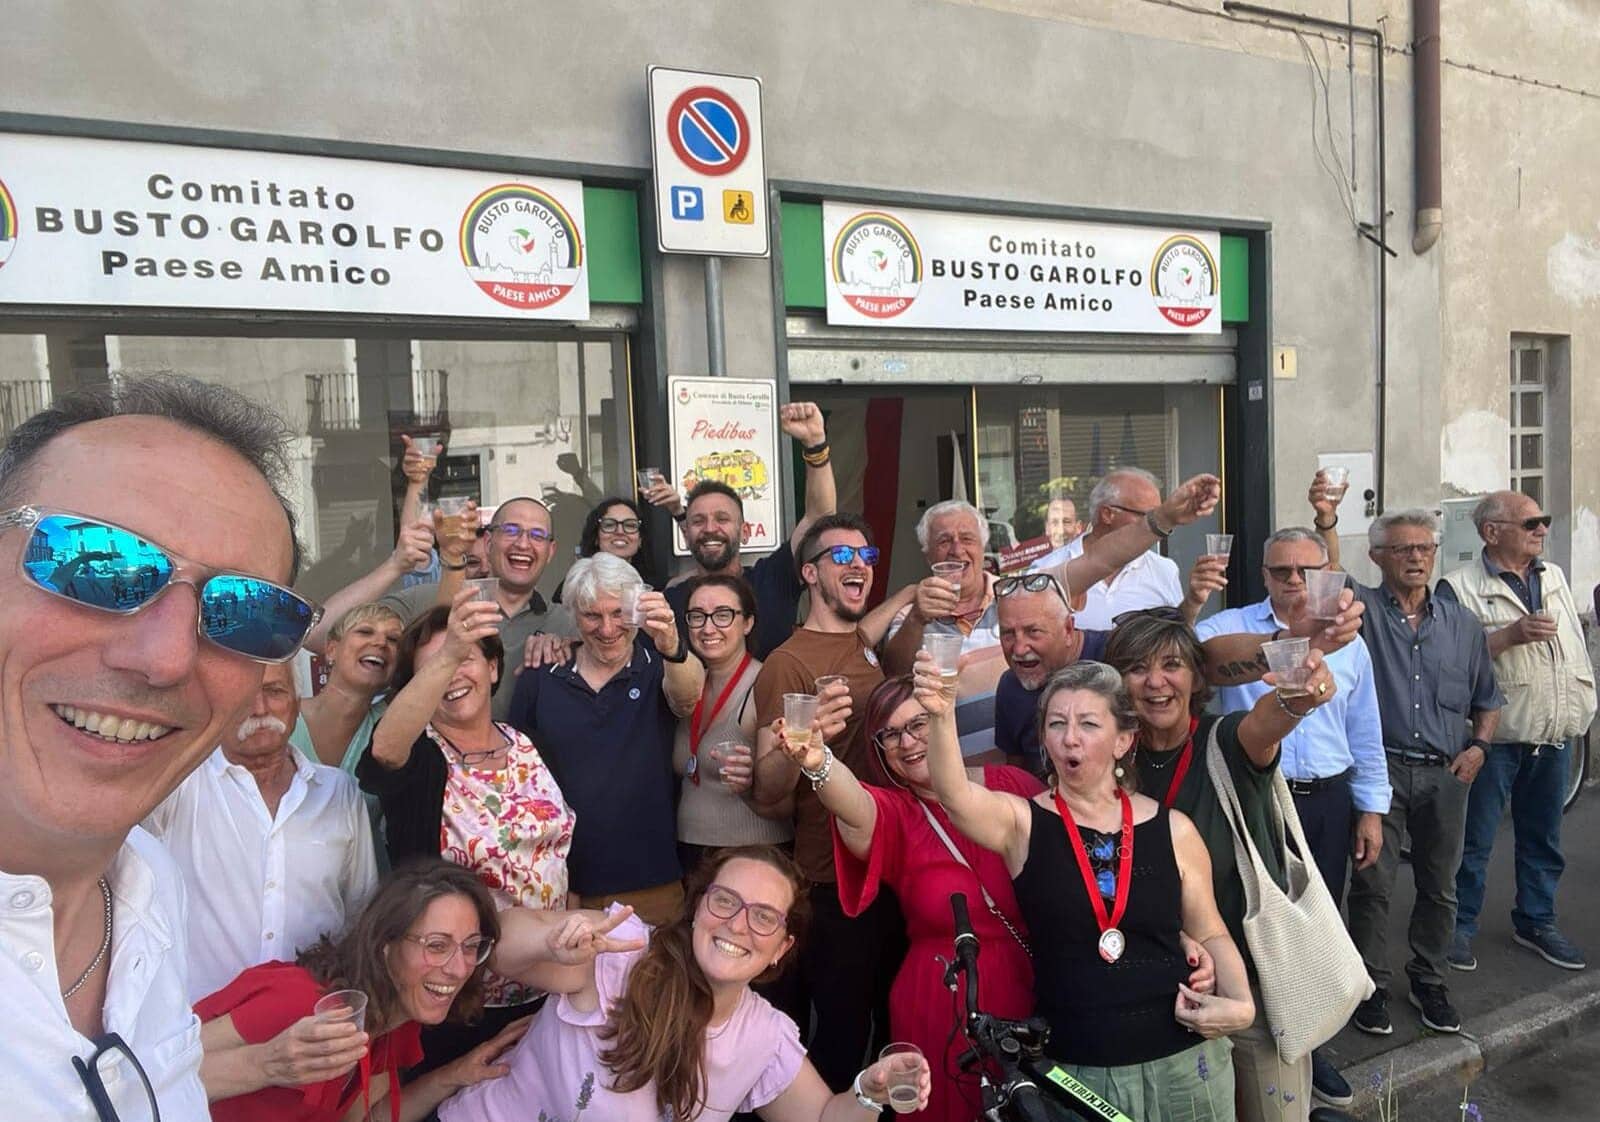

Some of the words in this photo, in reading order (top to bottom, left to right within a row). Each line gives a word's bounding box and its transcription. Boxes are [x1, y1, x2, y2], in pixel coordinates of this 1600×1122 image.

[147, 174, 355, 211] Comitato
[677, 190, 698, 217] P
[35, 207, 209, 240] BUSTO
[230, 216, 444, 252] GAROLFO
[478, 202, 510, 235] BUSTO
[515, 200, 566, 240] GAROLFO
[846, 228, 870, 256] BUSTO
[873, 226, 911, 258] GAROLFO
[989, 235, 1097, 259] Comitato
[101, 250, 243, 280] Paese
[260, 257, 391, 286] Amico
[931, 259, 1020, 281] BUSTO
[1029, 264, 1143, 287] GAROLFO
[492, 284, 526, 303] PAESE
[527, 286, 562, 304] AMICO
[963, 289, 1036, 310] Paese
[1044, 292, 1113, 312] Amico
[1279, 352, 1285, 370] 1
[691, 418, 757, 441] Piedibus
